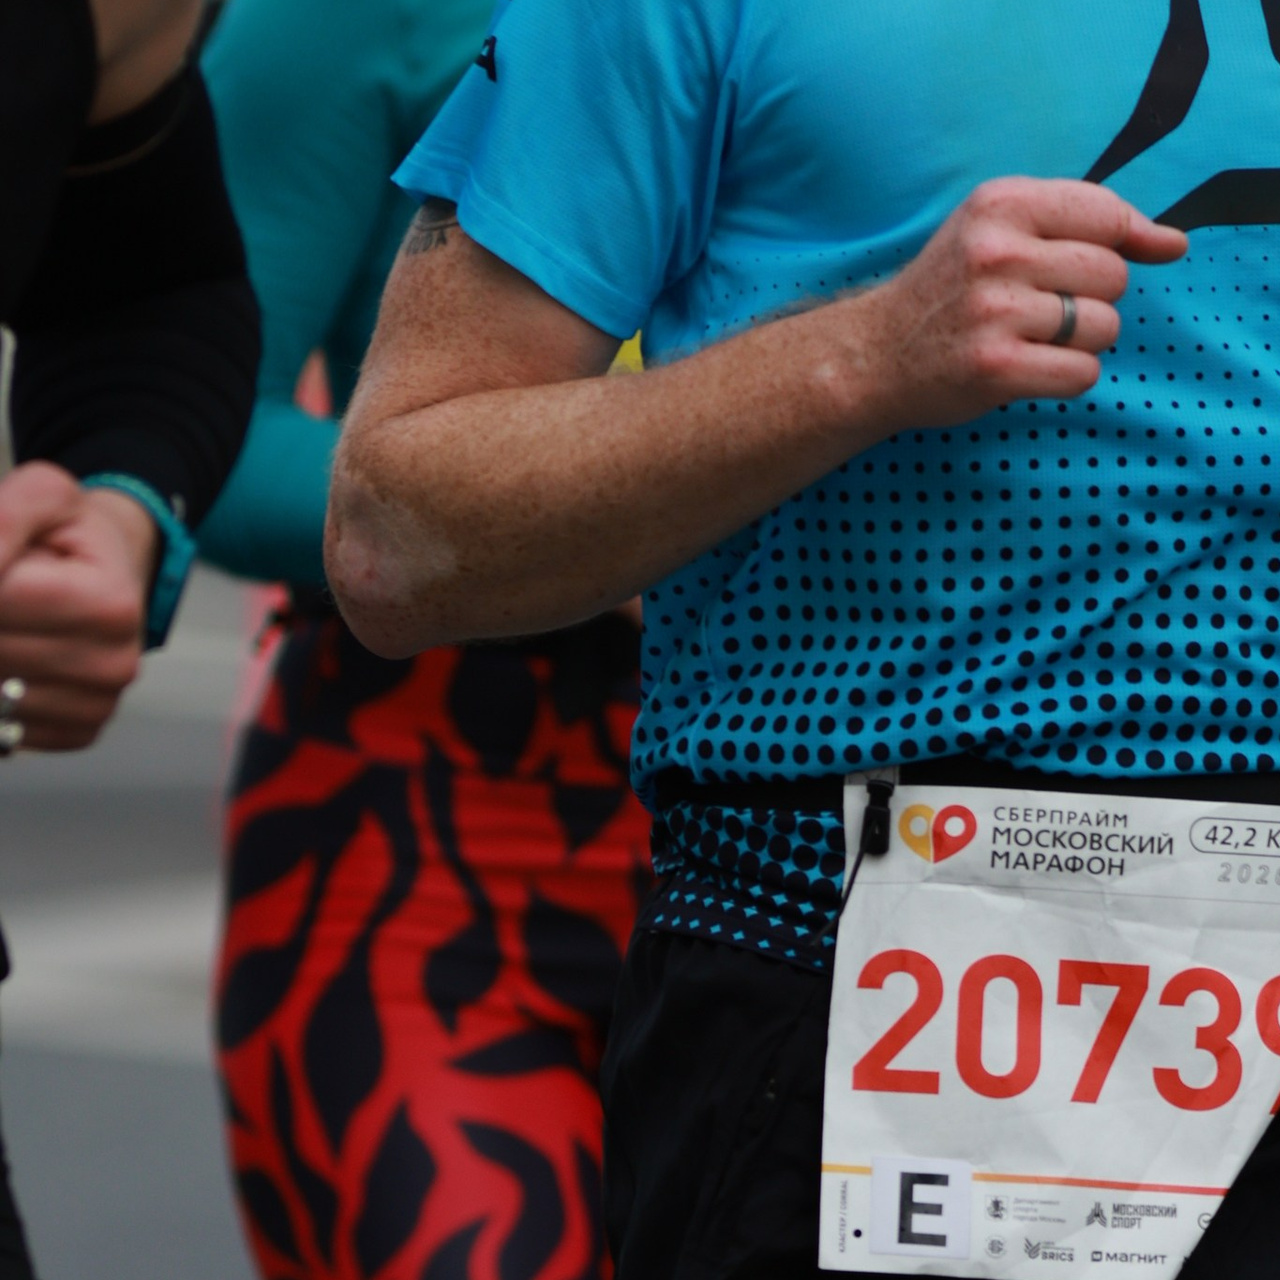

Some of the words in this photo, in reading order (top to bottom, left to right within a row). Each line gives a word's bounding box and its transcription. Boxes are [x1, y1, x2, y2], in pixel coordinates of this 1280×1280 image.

[993, 805, 1129, 829] СБЕРПРАЙМ
[992, 827, 1174, 855] МОСКОВСКИЙ
[1204, 825, 1257, 850] 42,2
[990, 850, 1126, 877] МАРАФОН
[1112, 1203, 1177, 1218] МОСКОВСКИЙ
[1111, 1217, 1142, 1229] СПОРТ
[1041, 1252, 1075, 1262] BRICS
